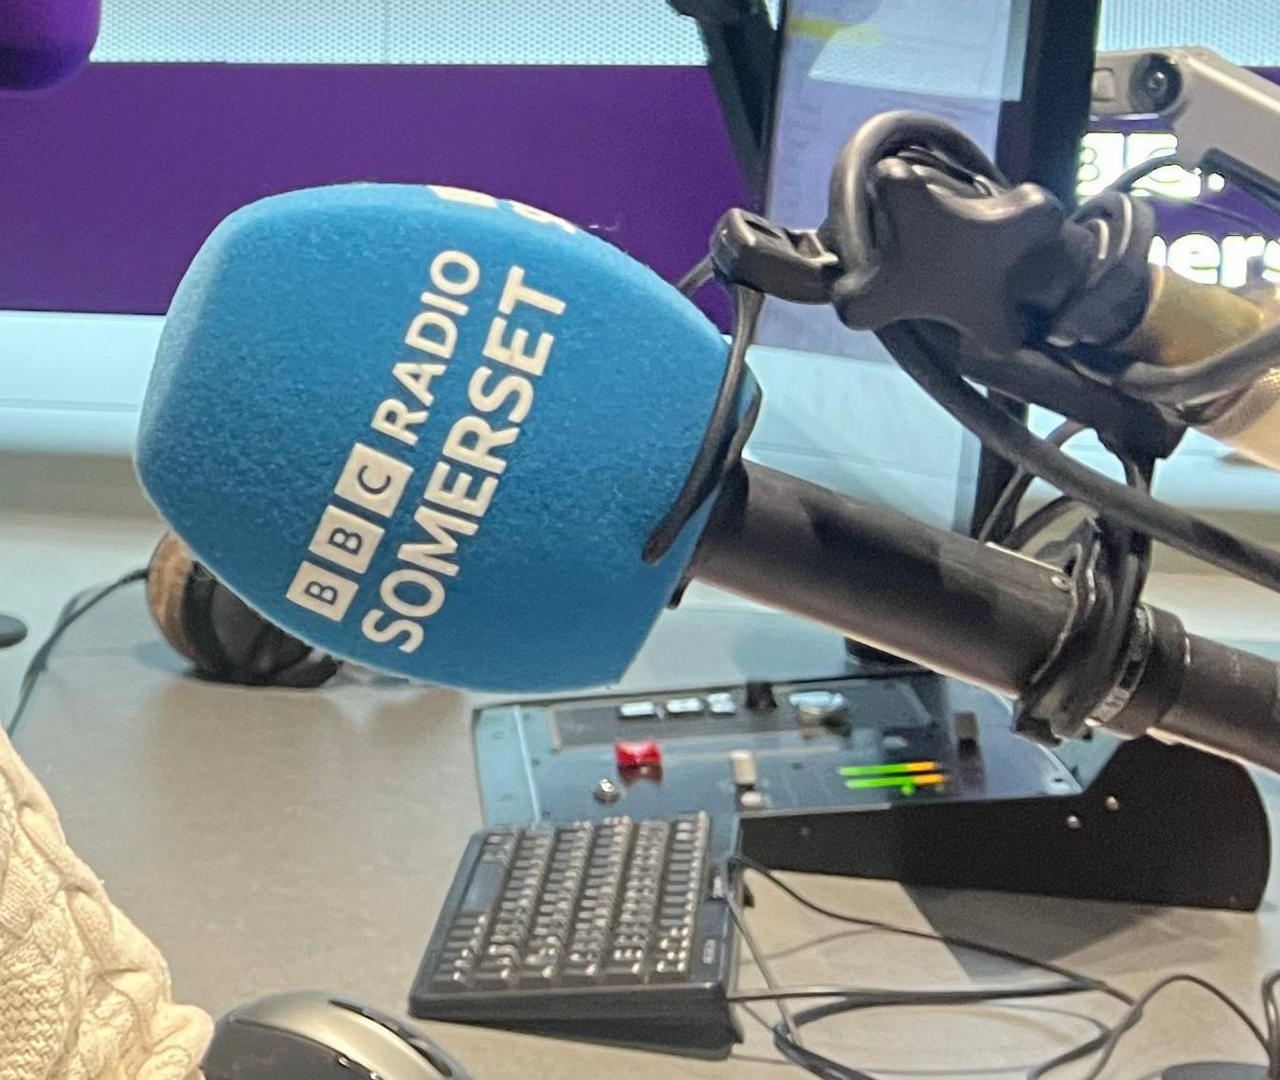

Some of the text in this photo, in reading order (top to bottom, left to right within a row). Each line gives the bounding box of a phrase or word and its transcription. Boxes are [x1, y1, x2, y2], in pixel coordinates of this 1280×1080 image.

[285, 442, 414, 621] BBC
[371, 250, 481, 446] RADIO
[361, 265, 567, 653] SOMERSET
